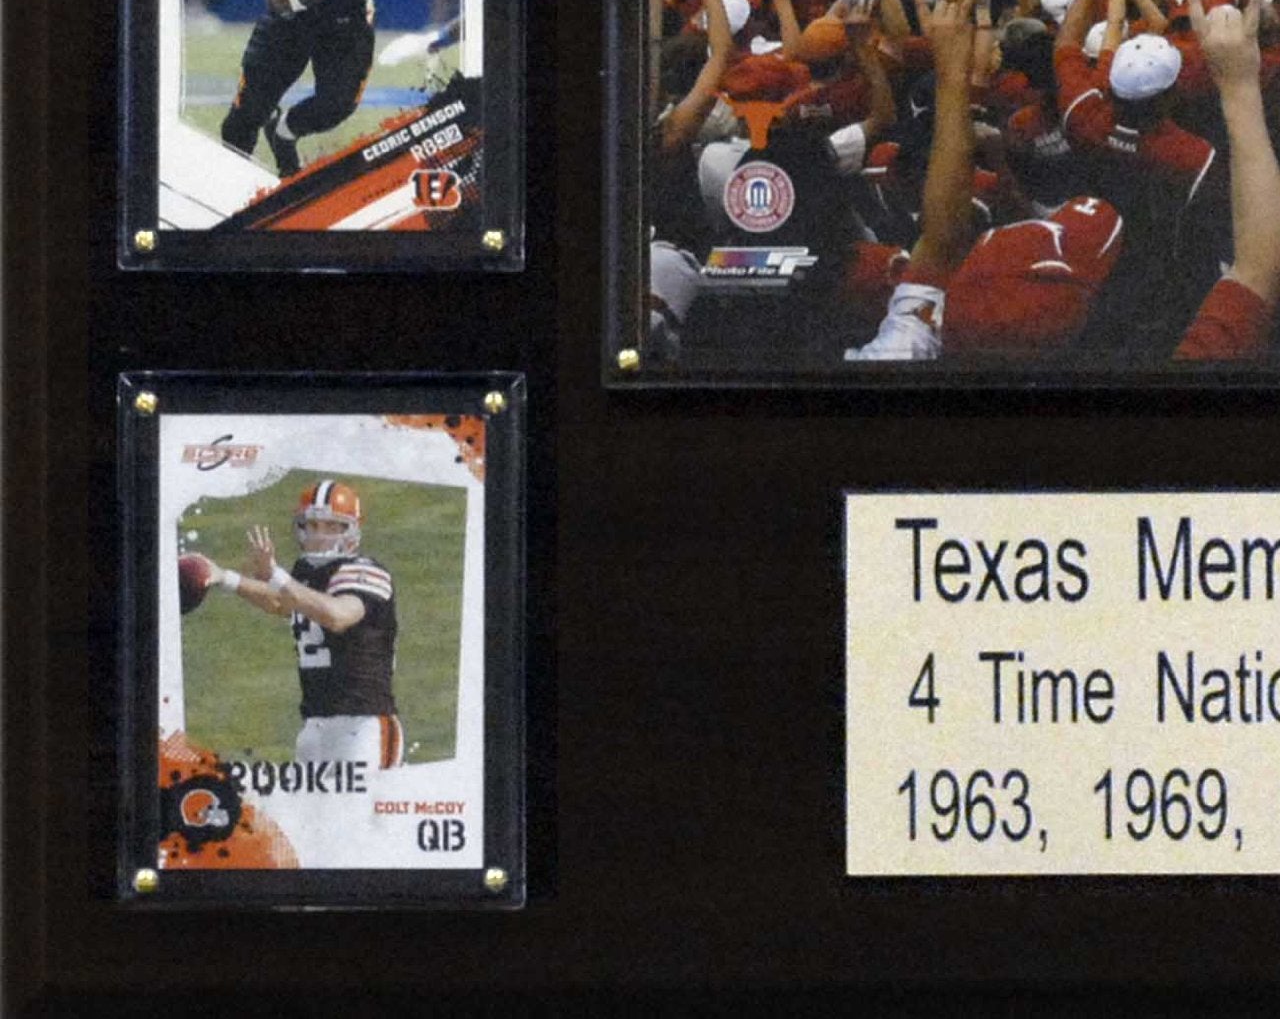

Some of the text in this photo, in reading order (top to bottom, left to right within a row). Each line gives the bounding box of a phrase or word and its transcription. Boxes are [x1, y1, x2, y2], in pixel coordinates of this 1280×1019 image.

[362, 99, 466, 162] CEDRIC BENSON
[895, 517, 1089, 604] Texas
[908, 652, 940, 724] 4
[978, 651, 1114, 724] Time
[374, 801, 409, 815] COLT
[417, 818, 466, 852] QB
[898, 769, 1047, 852] 1963,
[1094, 768, 1242, 851] 1969,
